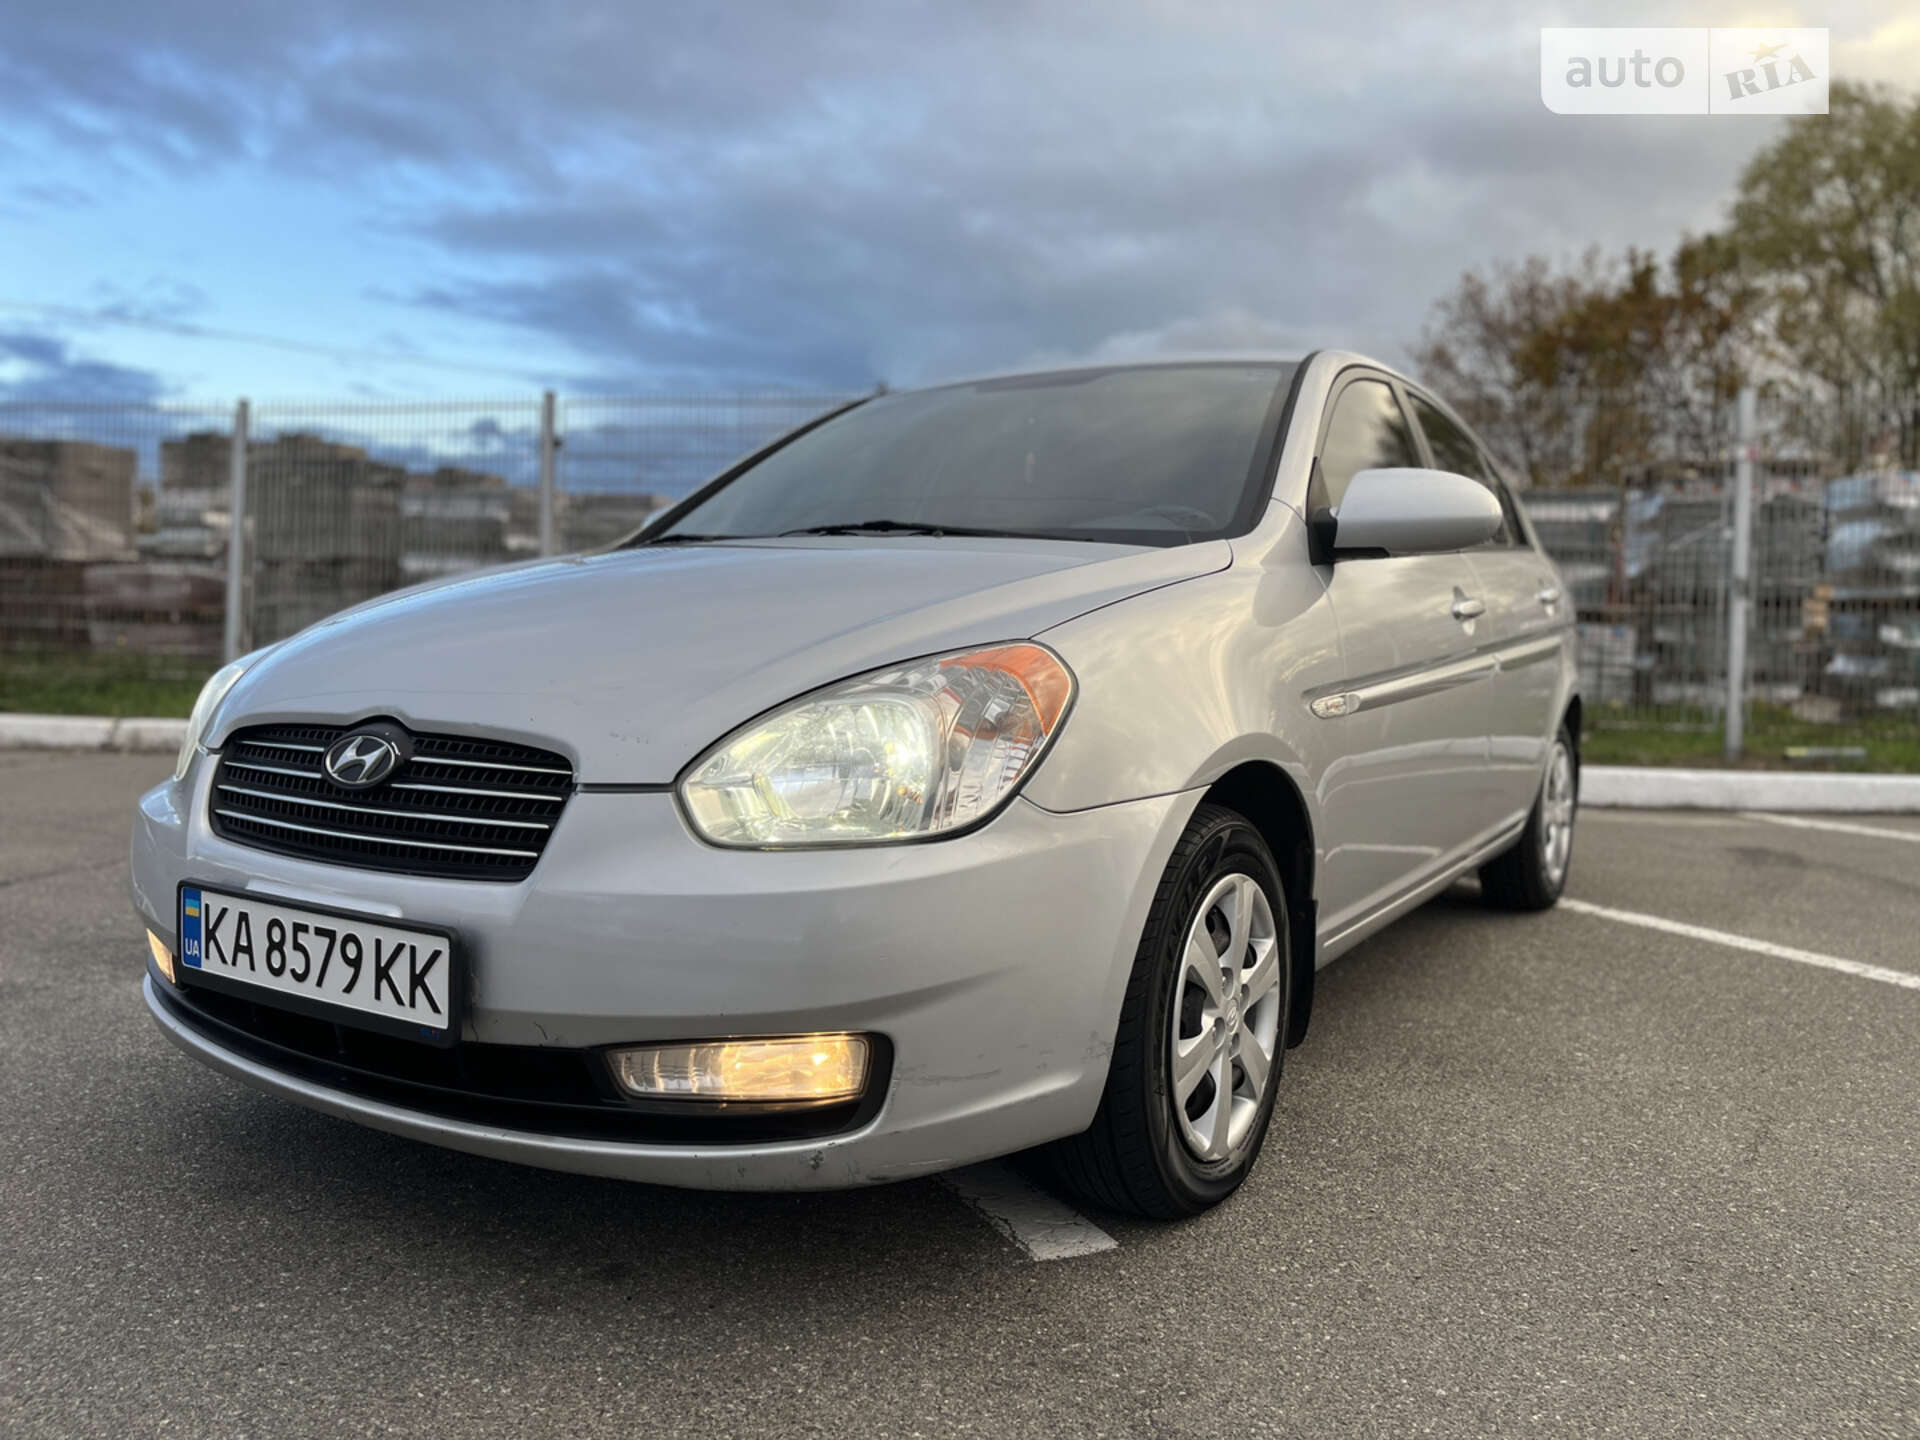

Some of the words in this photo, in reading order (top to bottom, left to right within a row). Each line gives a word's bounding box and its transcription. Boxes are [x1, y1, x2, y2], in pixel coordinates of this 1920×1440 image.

[185, 937, 200, 958] UA
[204, 902, 256, 972] KA
[264, 917, 363, 994] 8579
[374, 937, 442, 1015] KK
